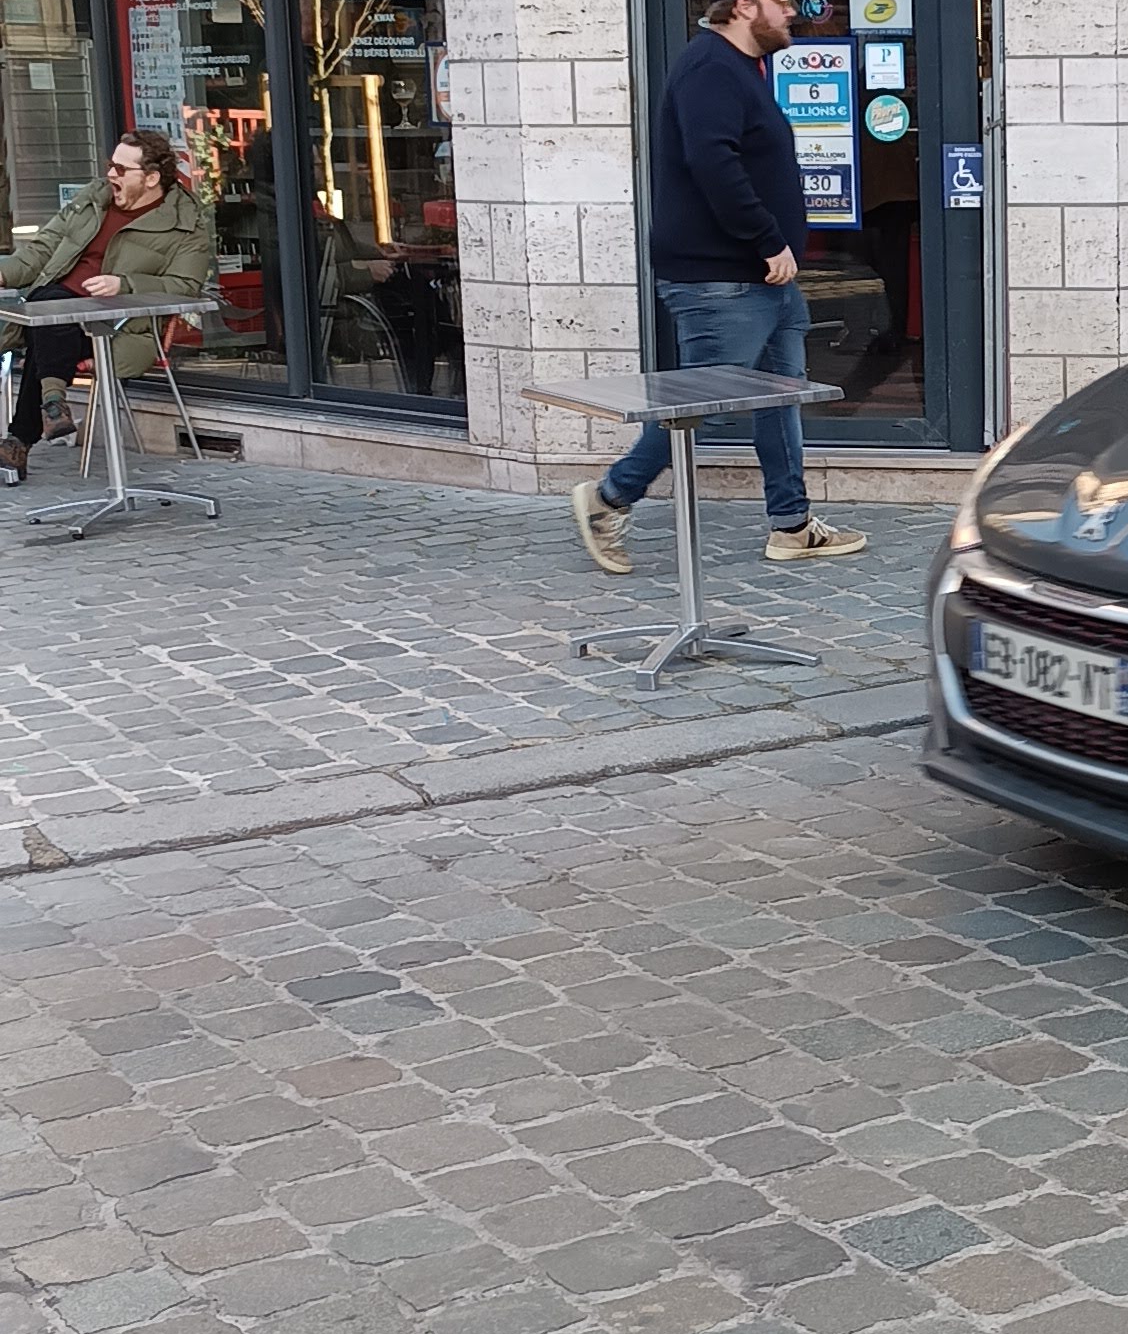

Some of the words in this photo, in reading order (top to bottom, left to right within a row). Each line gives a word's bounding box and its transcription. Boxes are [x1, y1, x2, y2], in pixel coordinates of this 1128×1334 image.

[798, 51, 844, 69] LOTO
[809, 83, 819, 100] 6
[805, 198, 839, 207] LIONS
